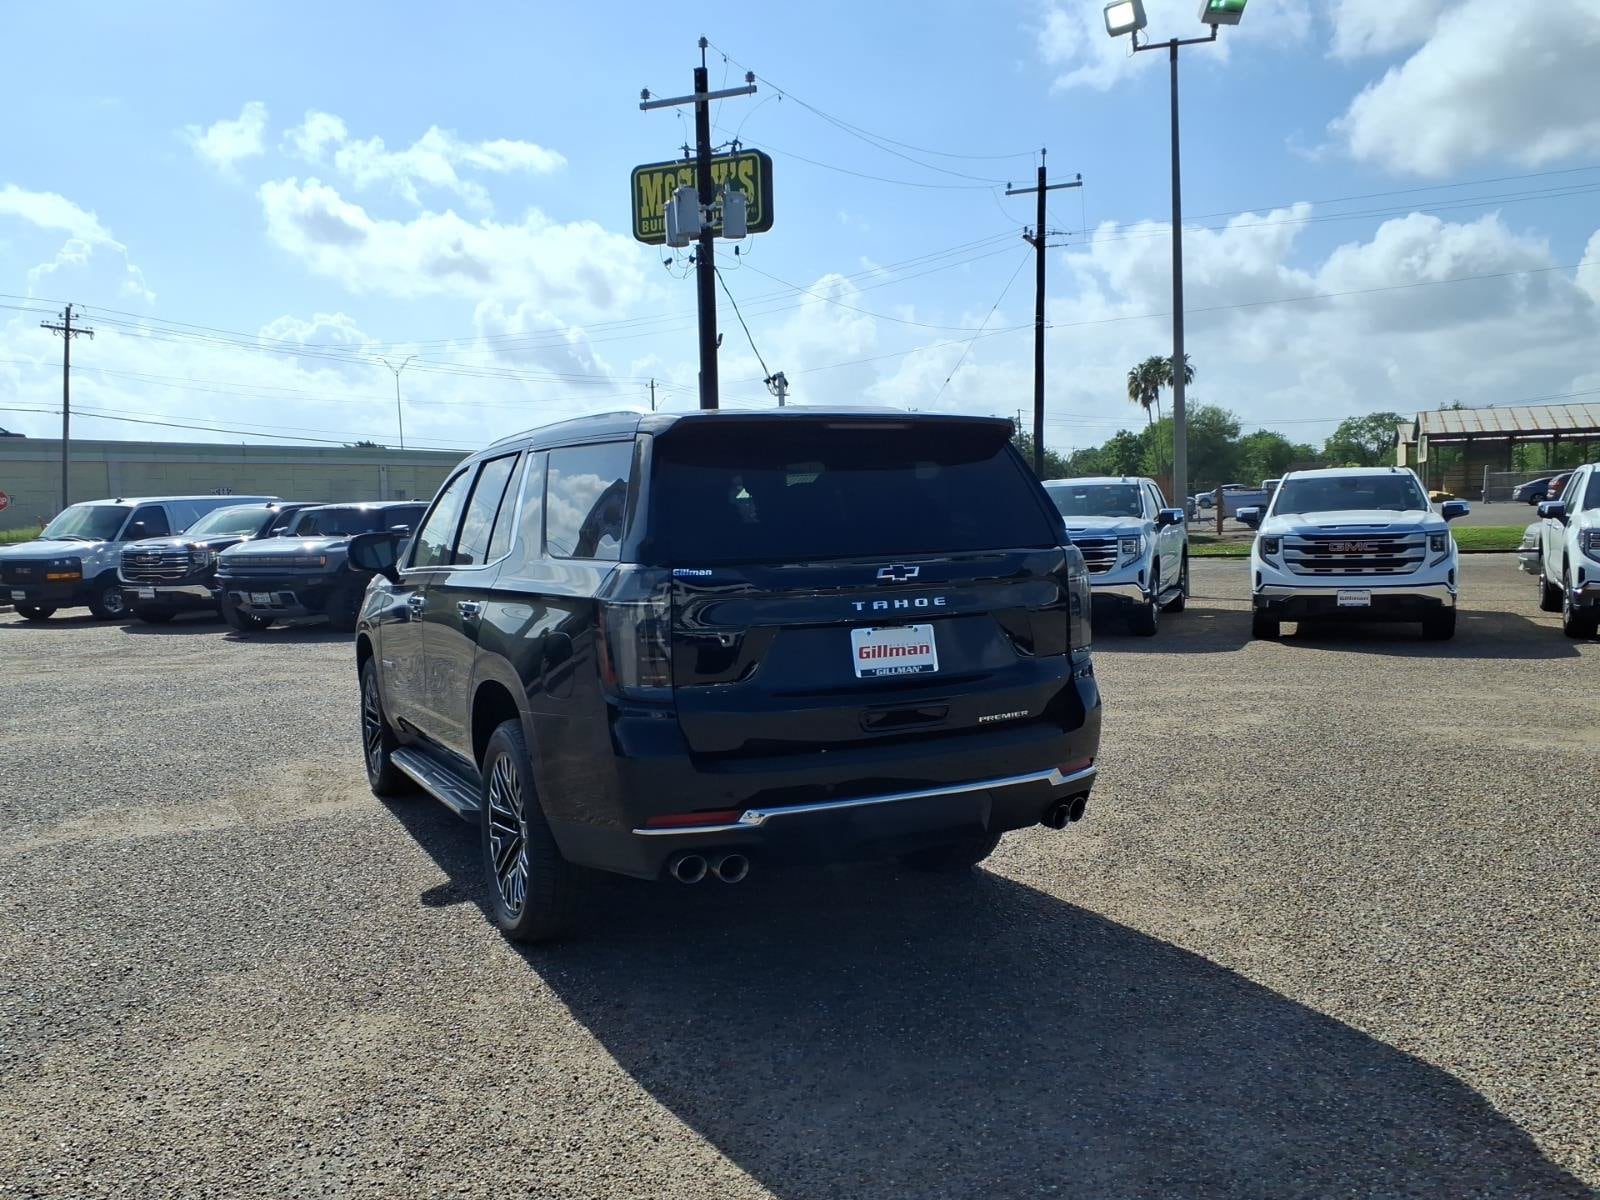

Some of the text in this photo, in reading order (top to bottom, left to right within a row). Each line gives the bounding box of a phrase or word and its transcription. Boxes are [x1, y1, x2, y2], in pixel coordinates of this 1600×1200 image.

[1329, 542, 1379, 551] GMC
[673, 568, 713, 576] Gillman
[852, 597, 947, 611] TAHOE
[858, 644, 930, 660] Gillman
[978, 710, 1029, 722] PREMIER
